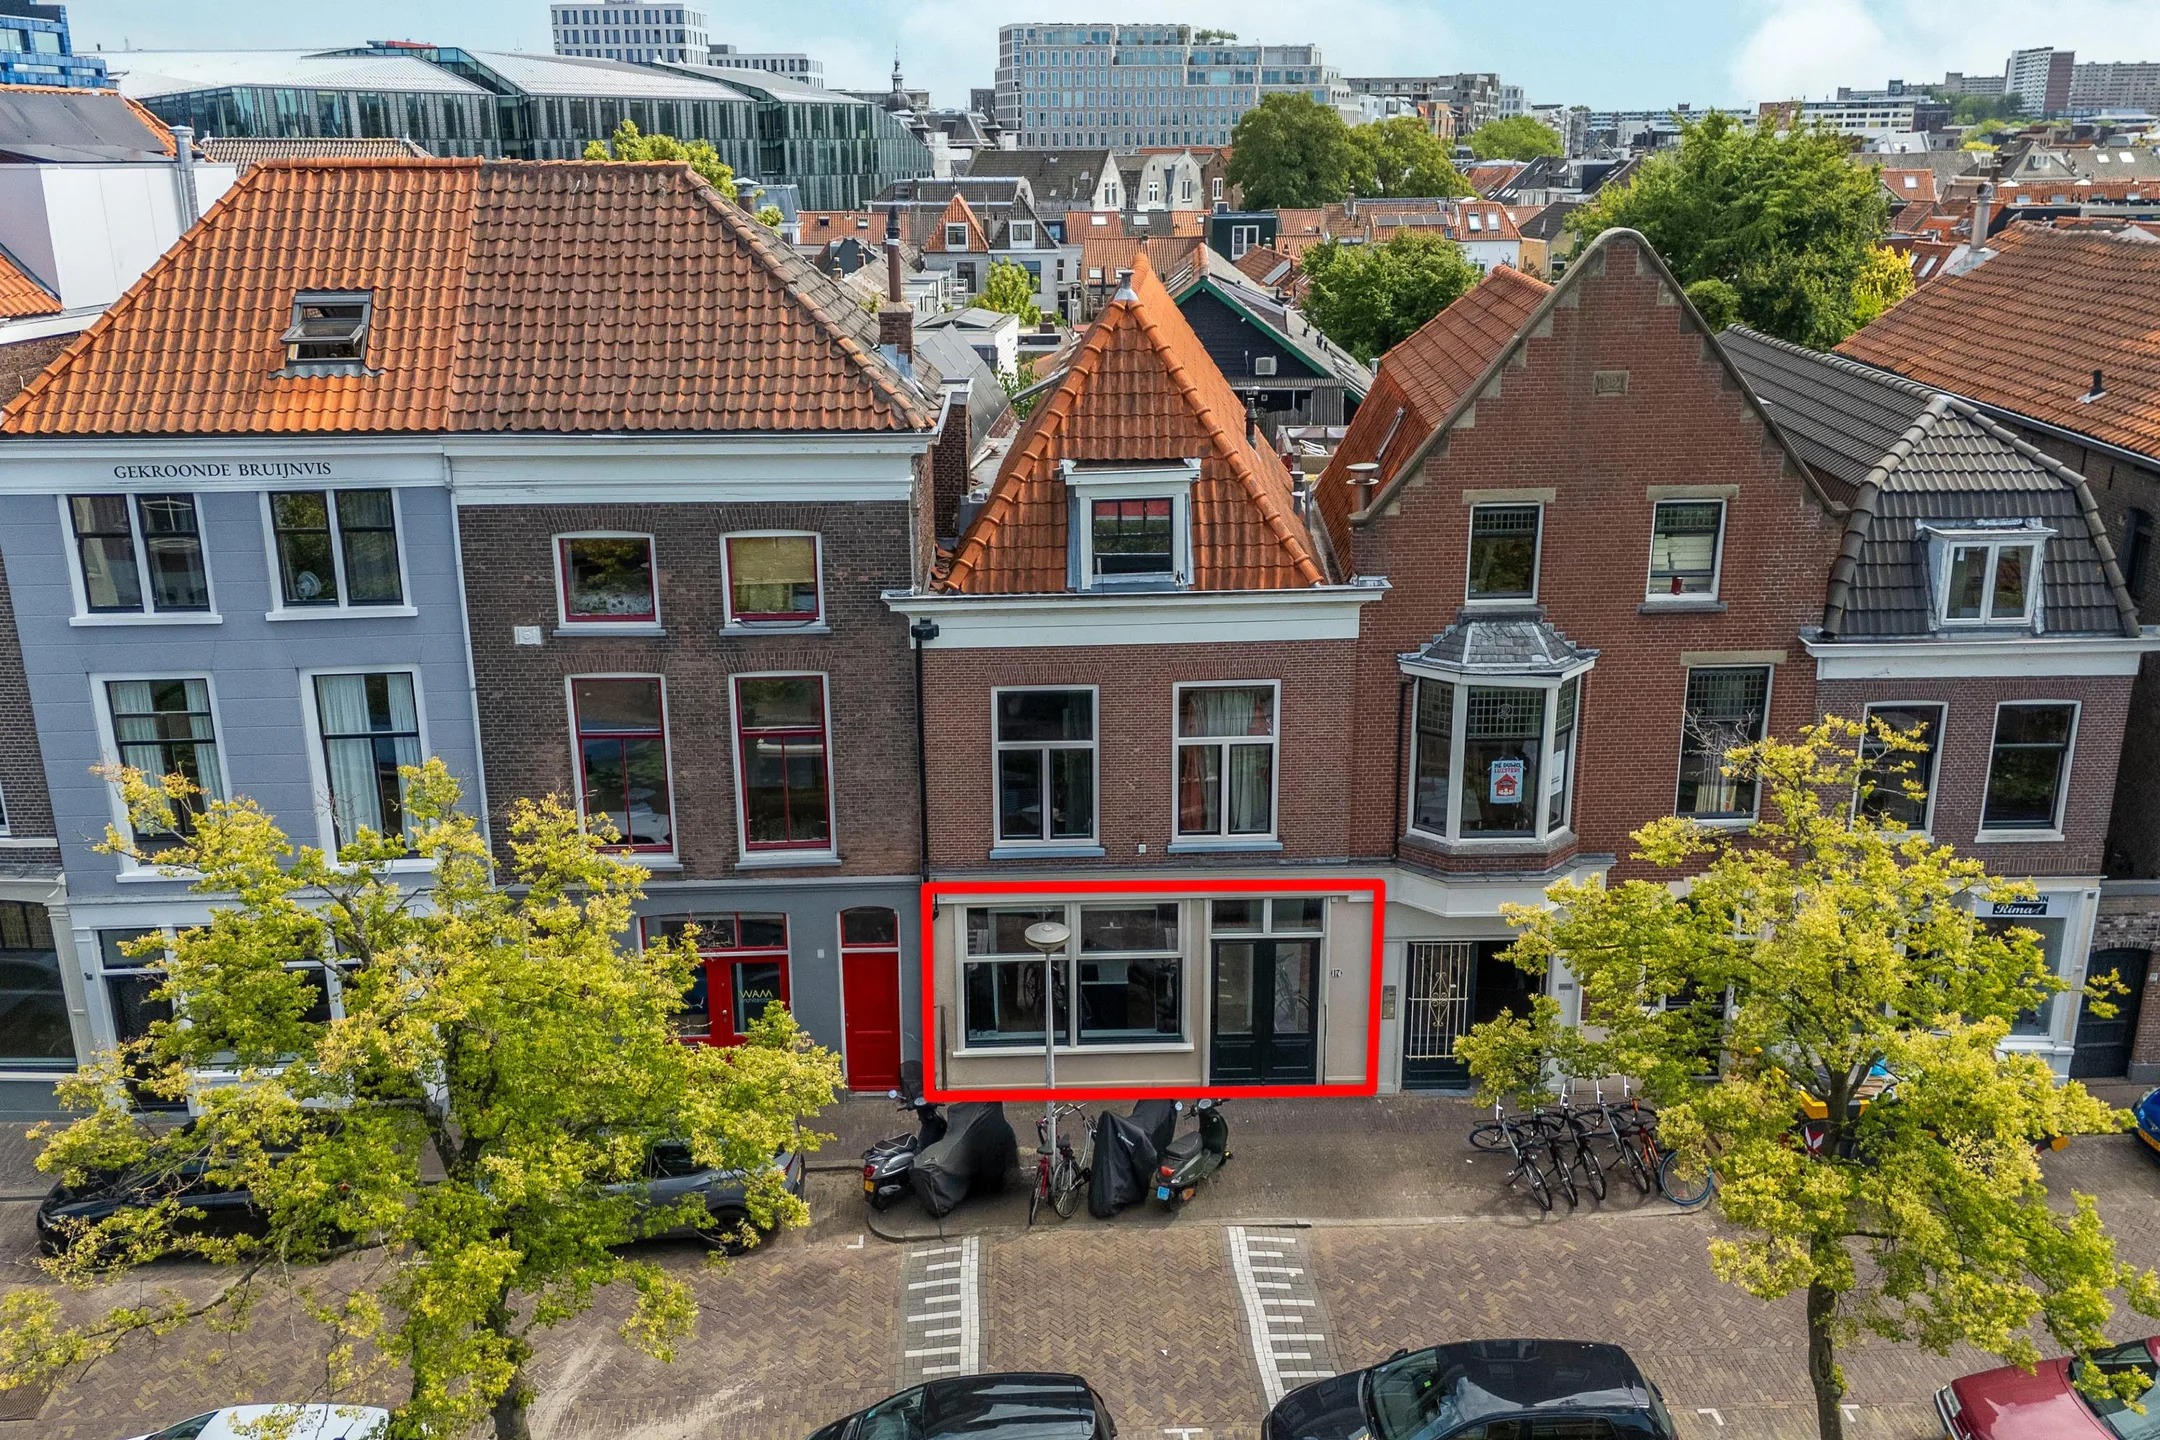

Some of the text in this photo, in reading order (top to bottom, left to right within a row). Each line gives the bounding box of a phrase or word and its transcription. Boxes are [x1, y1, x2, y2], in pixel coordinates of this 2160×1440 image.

[113, 461, 332, 479] GEKROONDE BRUIJNVIS
[1994, 903, 2033, 914] Rima
[740, 989, 773, 998] WAM
